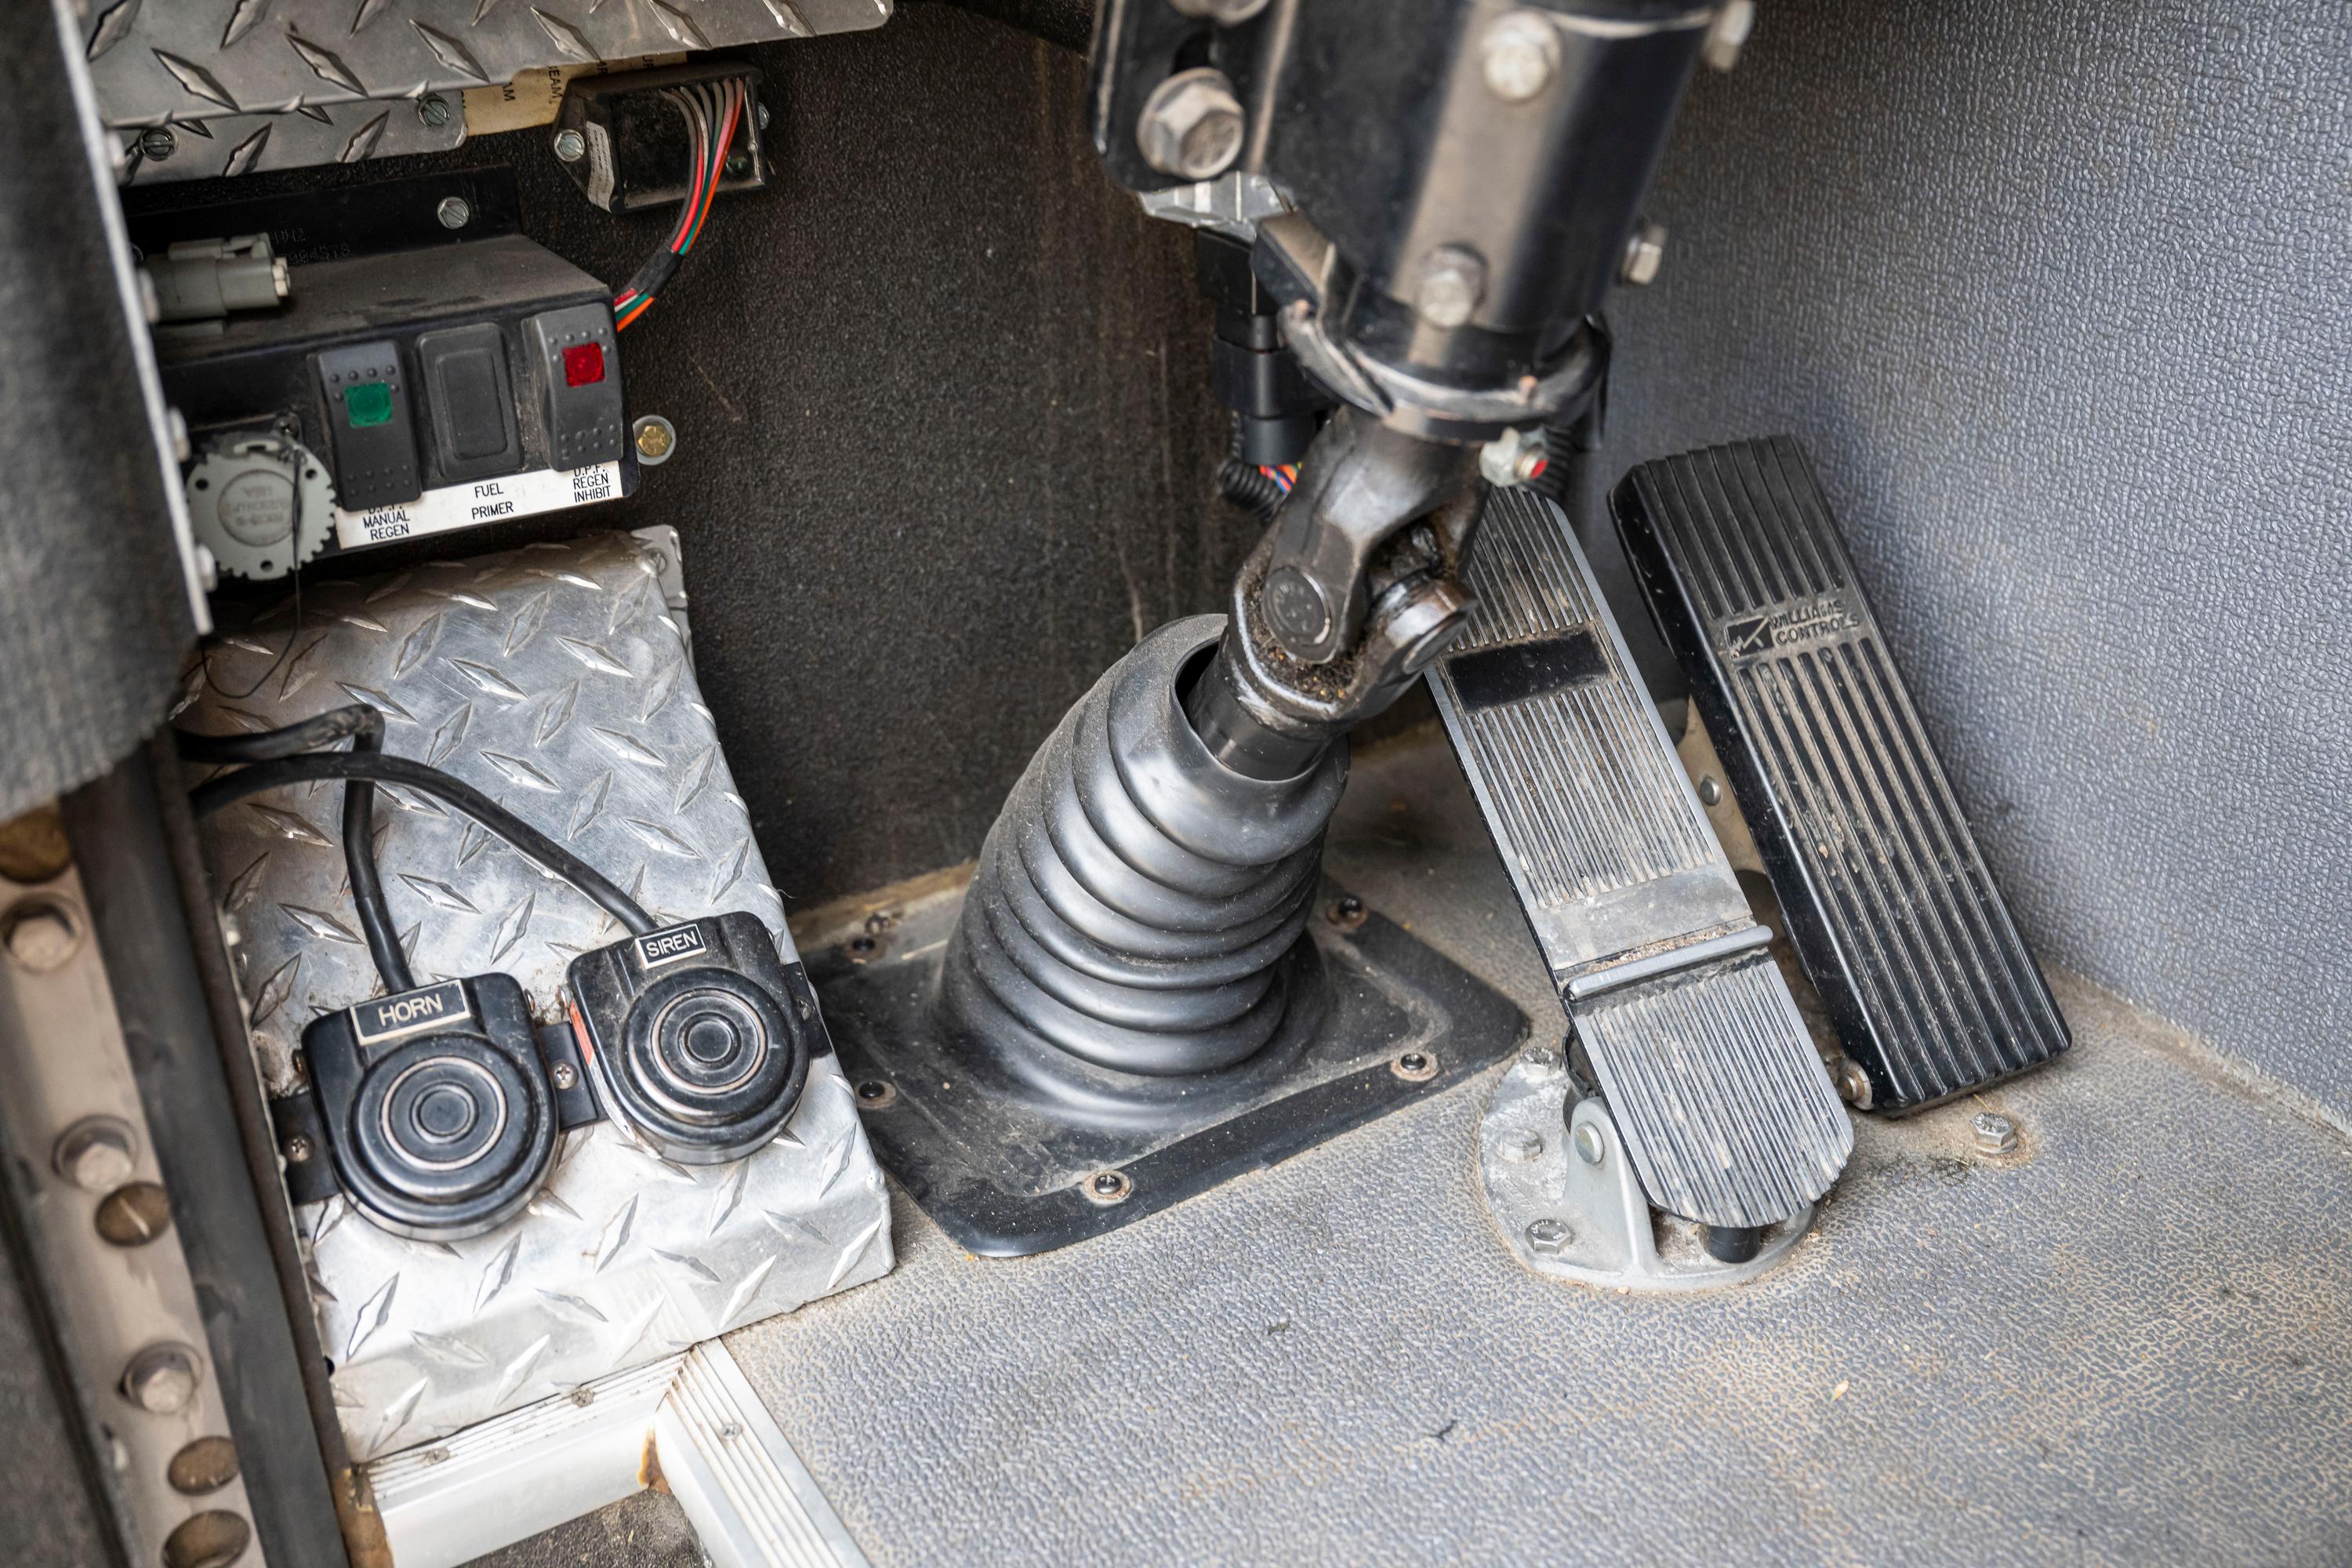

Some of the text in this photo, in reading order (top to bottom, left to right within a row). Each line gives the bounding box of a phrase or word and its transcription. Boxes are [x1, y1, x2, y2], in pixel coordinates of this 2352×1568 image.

[573, 472, 609, 490] REGEN
[474, 483, 504, 499] FUEL
[574, 485, 611, 503] INHIBIT
[363, 509, 410, 528] MANUAL
[471, 501, 514, 520] PRIMER
[370, 523, 409, 541] REGEN
[645, 931, 698, 958] SIREN
[378, 993, 443, 1027] HORN
